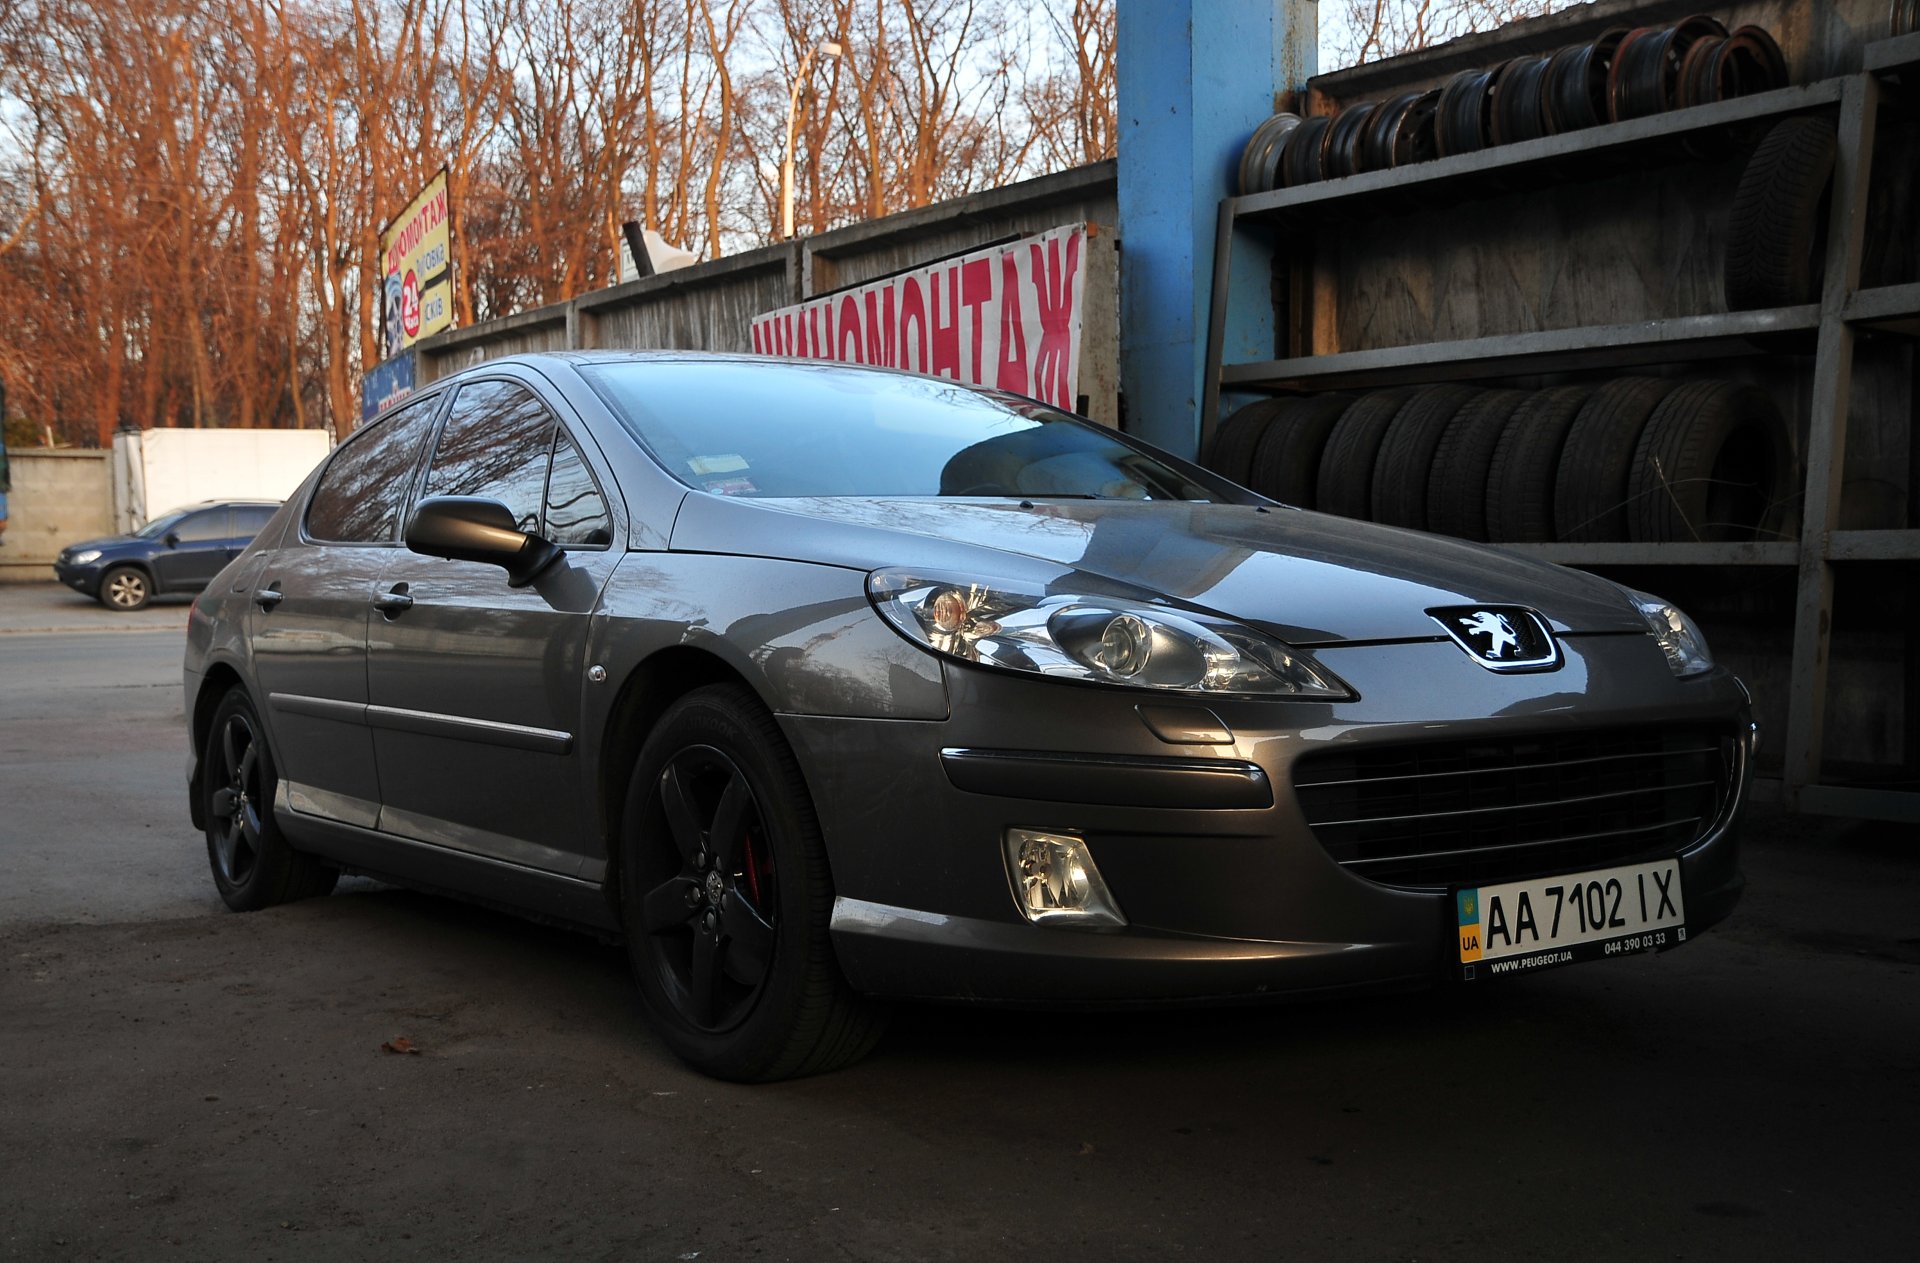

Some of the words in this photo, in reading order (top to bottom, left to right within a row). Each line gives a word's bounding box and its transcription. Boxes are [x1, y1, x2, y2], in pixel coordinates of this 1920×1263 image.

[404, 281, 419, 316] 24
[1486, 891, 1539, 949] AA
[1545, 878, 1625, 938] 7102
[1637, 869, 1677, 922] IX
[1462, 936, 1479, 951] UA
[1604, 940, 1622, 955] 044
[1624, 937, 1641, 951] 390
[1642, 935, 1653, 947] 03
[1655, 932, 1666, 945] 33
[1491, 951, 1573, 974] WWW.PEUGEOT.UA
